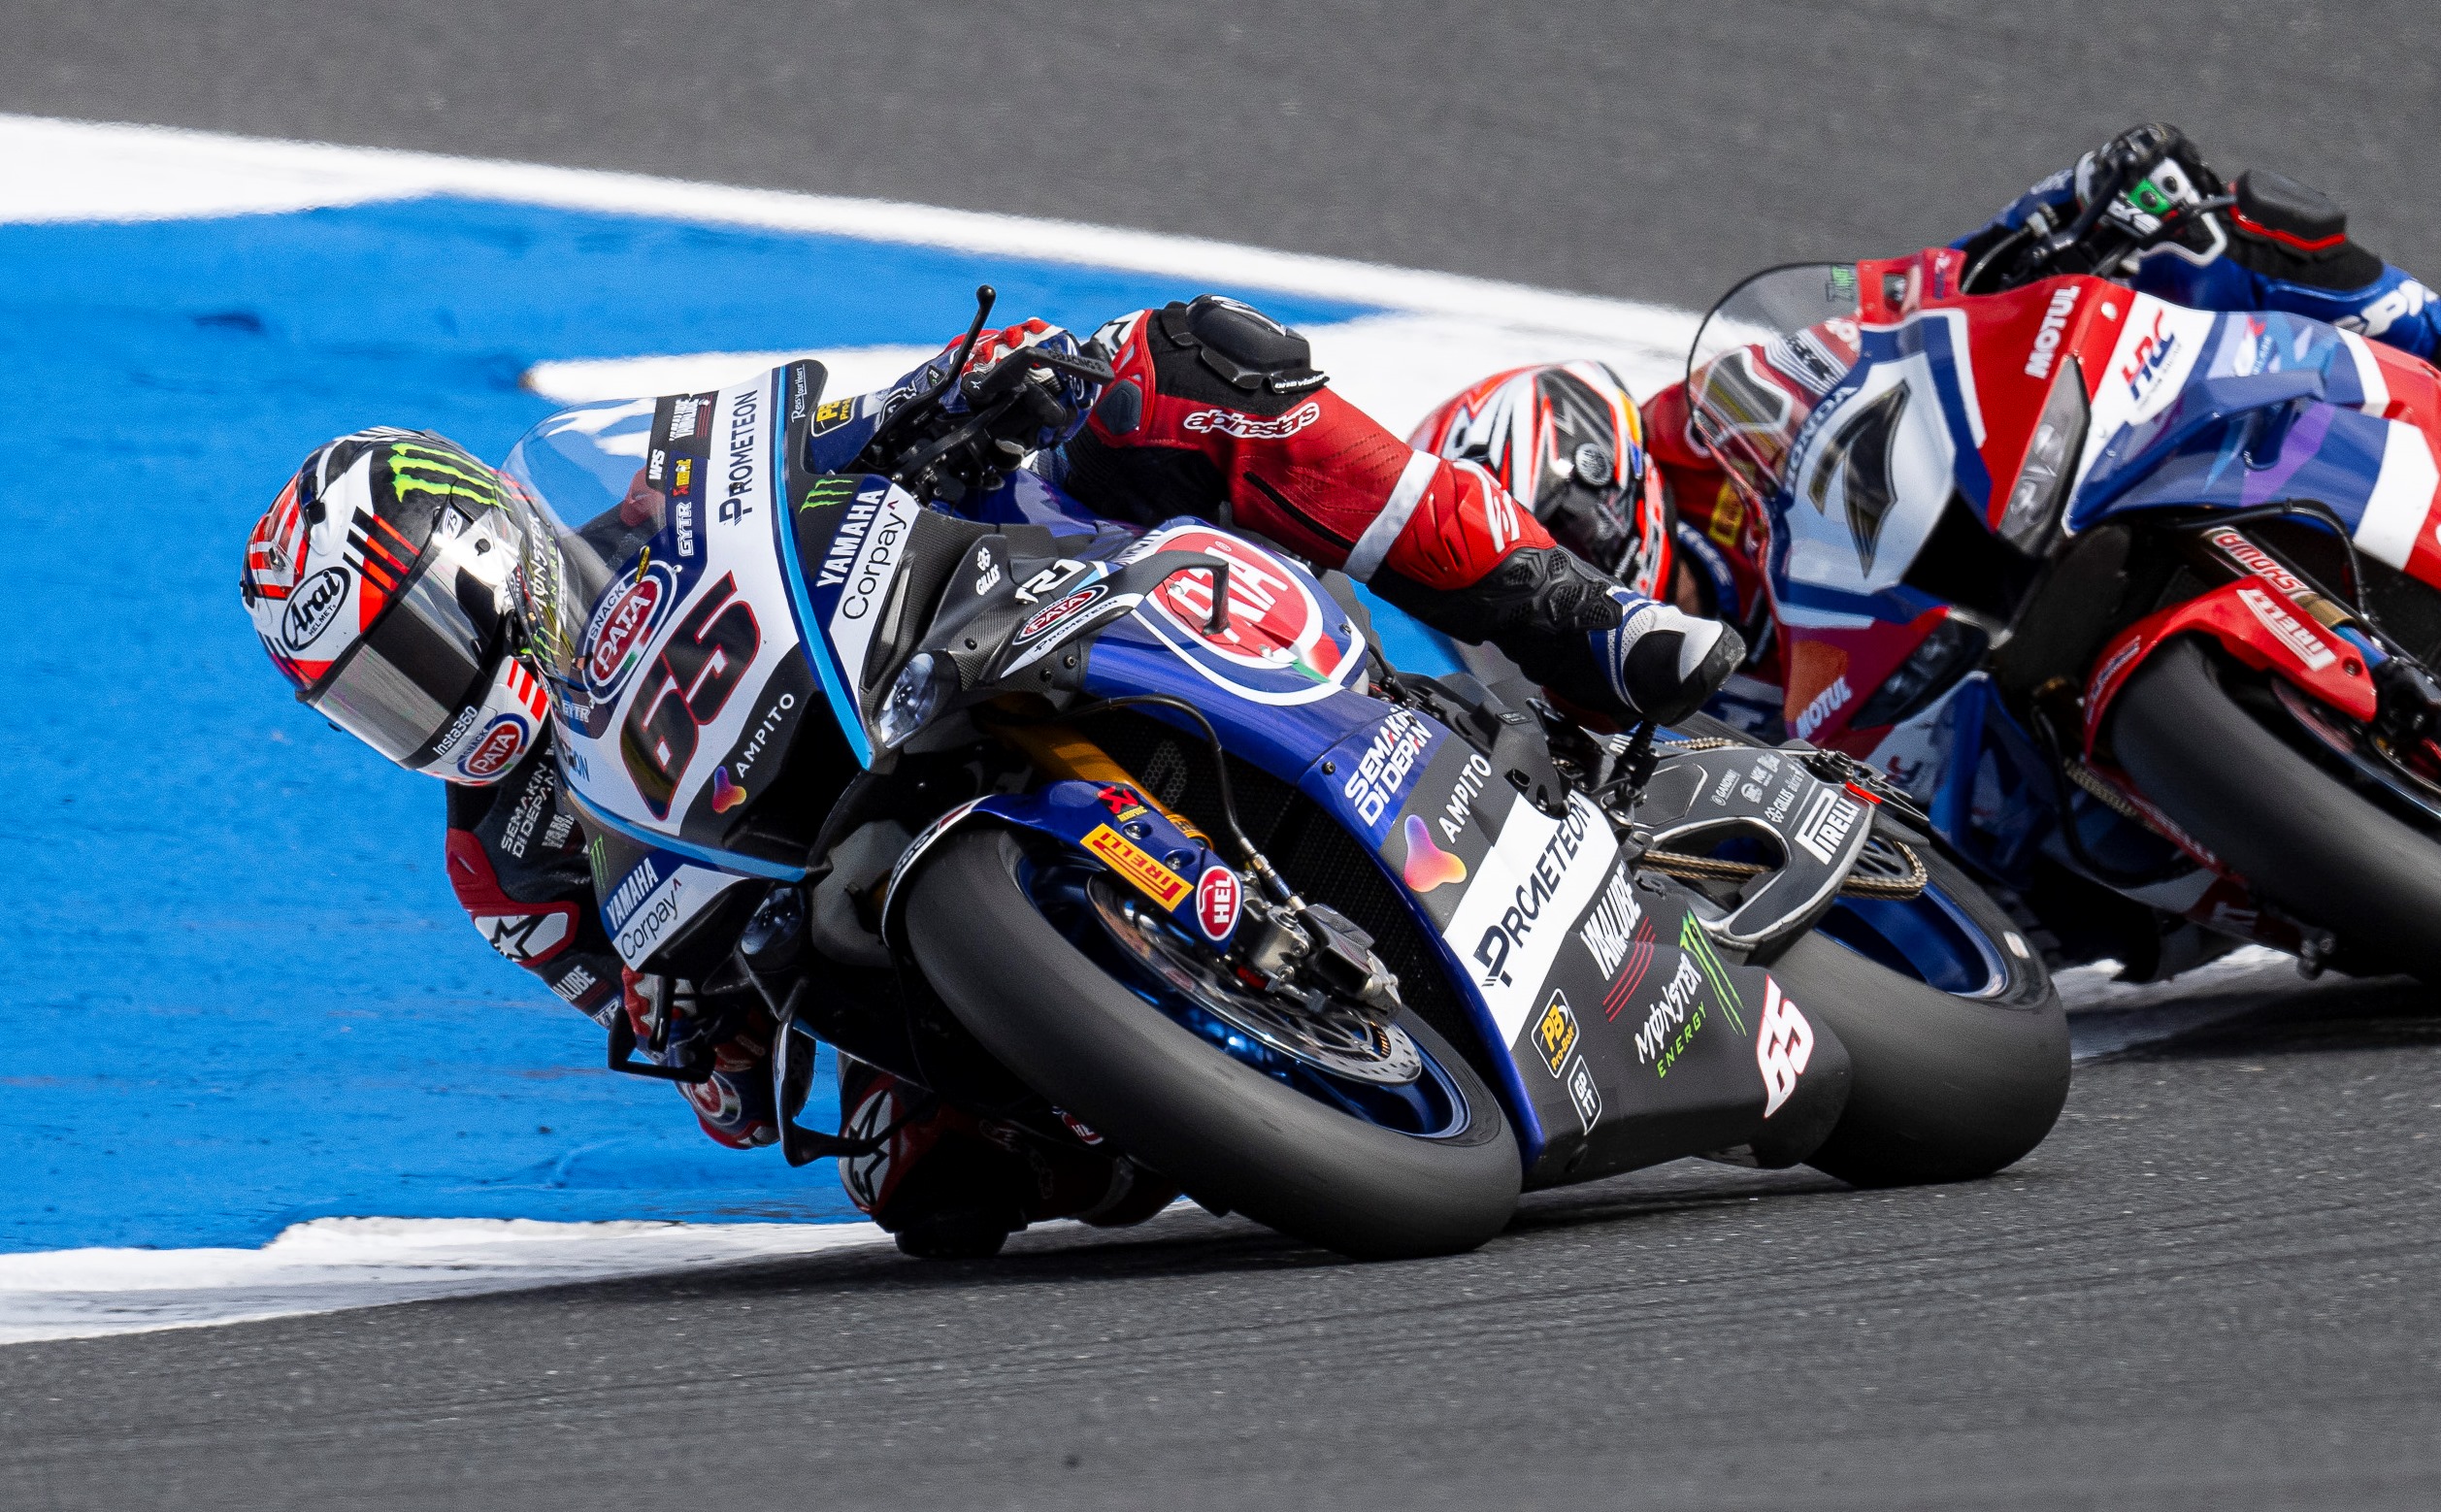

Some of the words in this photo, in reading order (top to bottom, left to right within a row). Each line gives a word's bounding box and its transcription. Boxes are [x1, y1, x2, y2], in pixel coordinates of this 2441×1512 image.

[2025, 285, 2080, 378] MOTUL
[2122, 309, 2174, 401] HRC
[1183, 402, 1320, 439] alpinestars
[719, 390, 758, 526] PROMETEON
[676, 502, 693, 556] GYTR
[816, 487, 886, 588] YAMAHA
[842, 510, 908, 620] Corpay
[2213, 532, 2303, 594] SHOWA
[290, 570, 341, 649] Arai
[590, 584, 626, 641] SNACK
[976, 564, 1001, 595] GILLES
[1033, 596, 1085, 630] PATA
[309, 605, 336, 636] HELMET
[598, 592, 653, 672] PATA
[1035, 599, 1117, 652] PROMETEON
[2237, 587, 2336, 672] PIRELLI
[433, 706, 478, 755] Insta360
[619, 570, 761, 820] 65
[1796, 675, 1854, 740] MOTUL
[475, 733, 514, 772] PATA
[736, 692, 795, 778] AMPITO
[1344, 706, 1417, 806] SEMAKIN
[1380, 721, 1433, 794] DEPAN
[501, 762, 547, 852] SEMAKIN
[1437, 752, 1492, 843] AMPITO
[1772, 788, 1795, 812] GILLES
[1795, 787, 1861, 866] PIRELLI
[607, 856, 659, 932] YAMAHA
[1093, 832, 1182, 903] PIRELLI
[1214, 876, 1231, 923] HEL
[1472, 791, 1592, 988] PROMETEON
[620, 890, 679, 961] Corpay
[1580, 859, 1642, 981] YAMALUBE
[553, 965, 597, 1003] ALUBE
[1541, 1004, 1565, 1053] PB
[1551, 1024, 1574, 1070] Pro-Bolt
[1656, 1001, 1707, 1078] ENERGY
[1757, 974, 1814, 1119] 65
